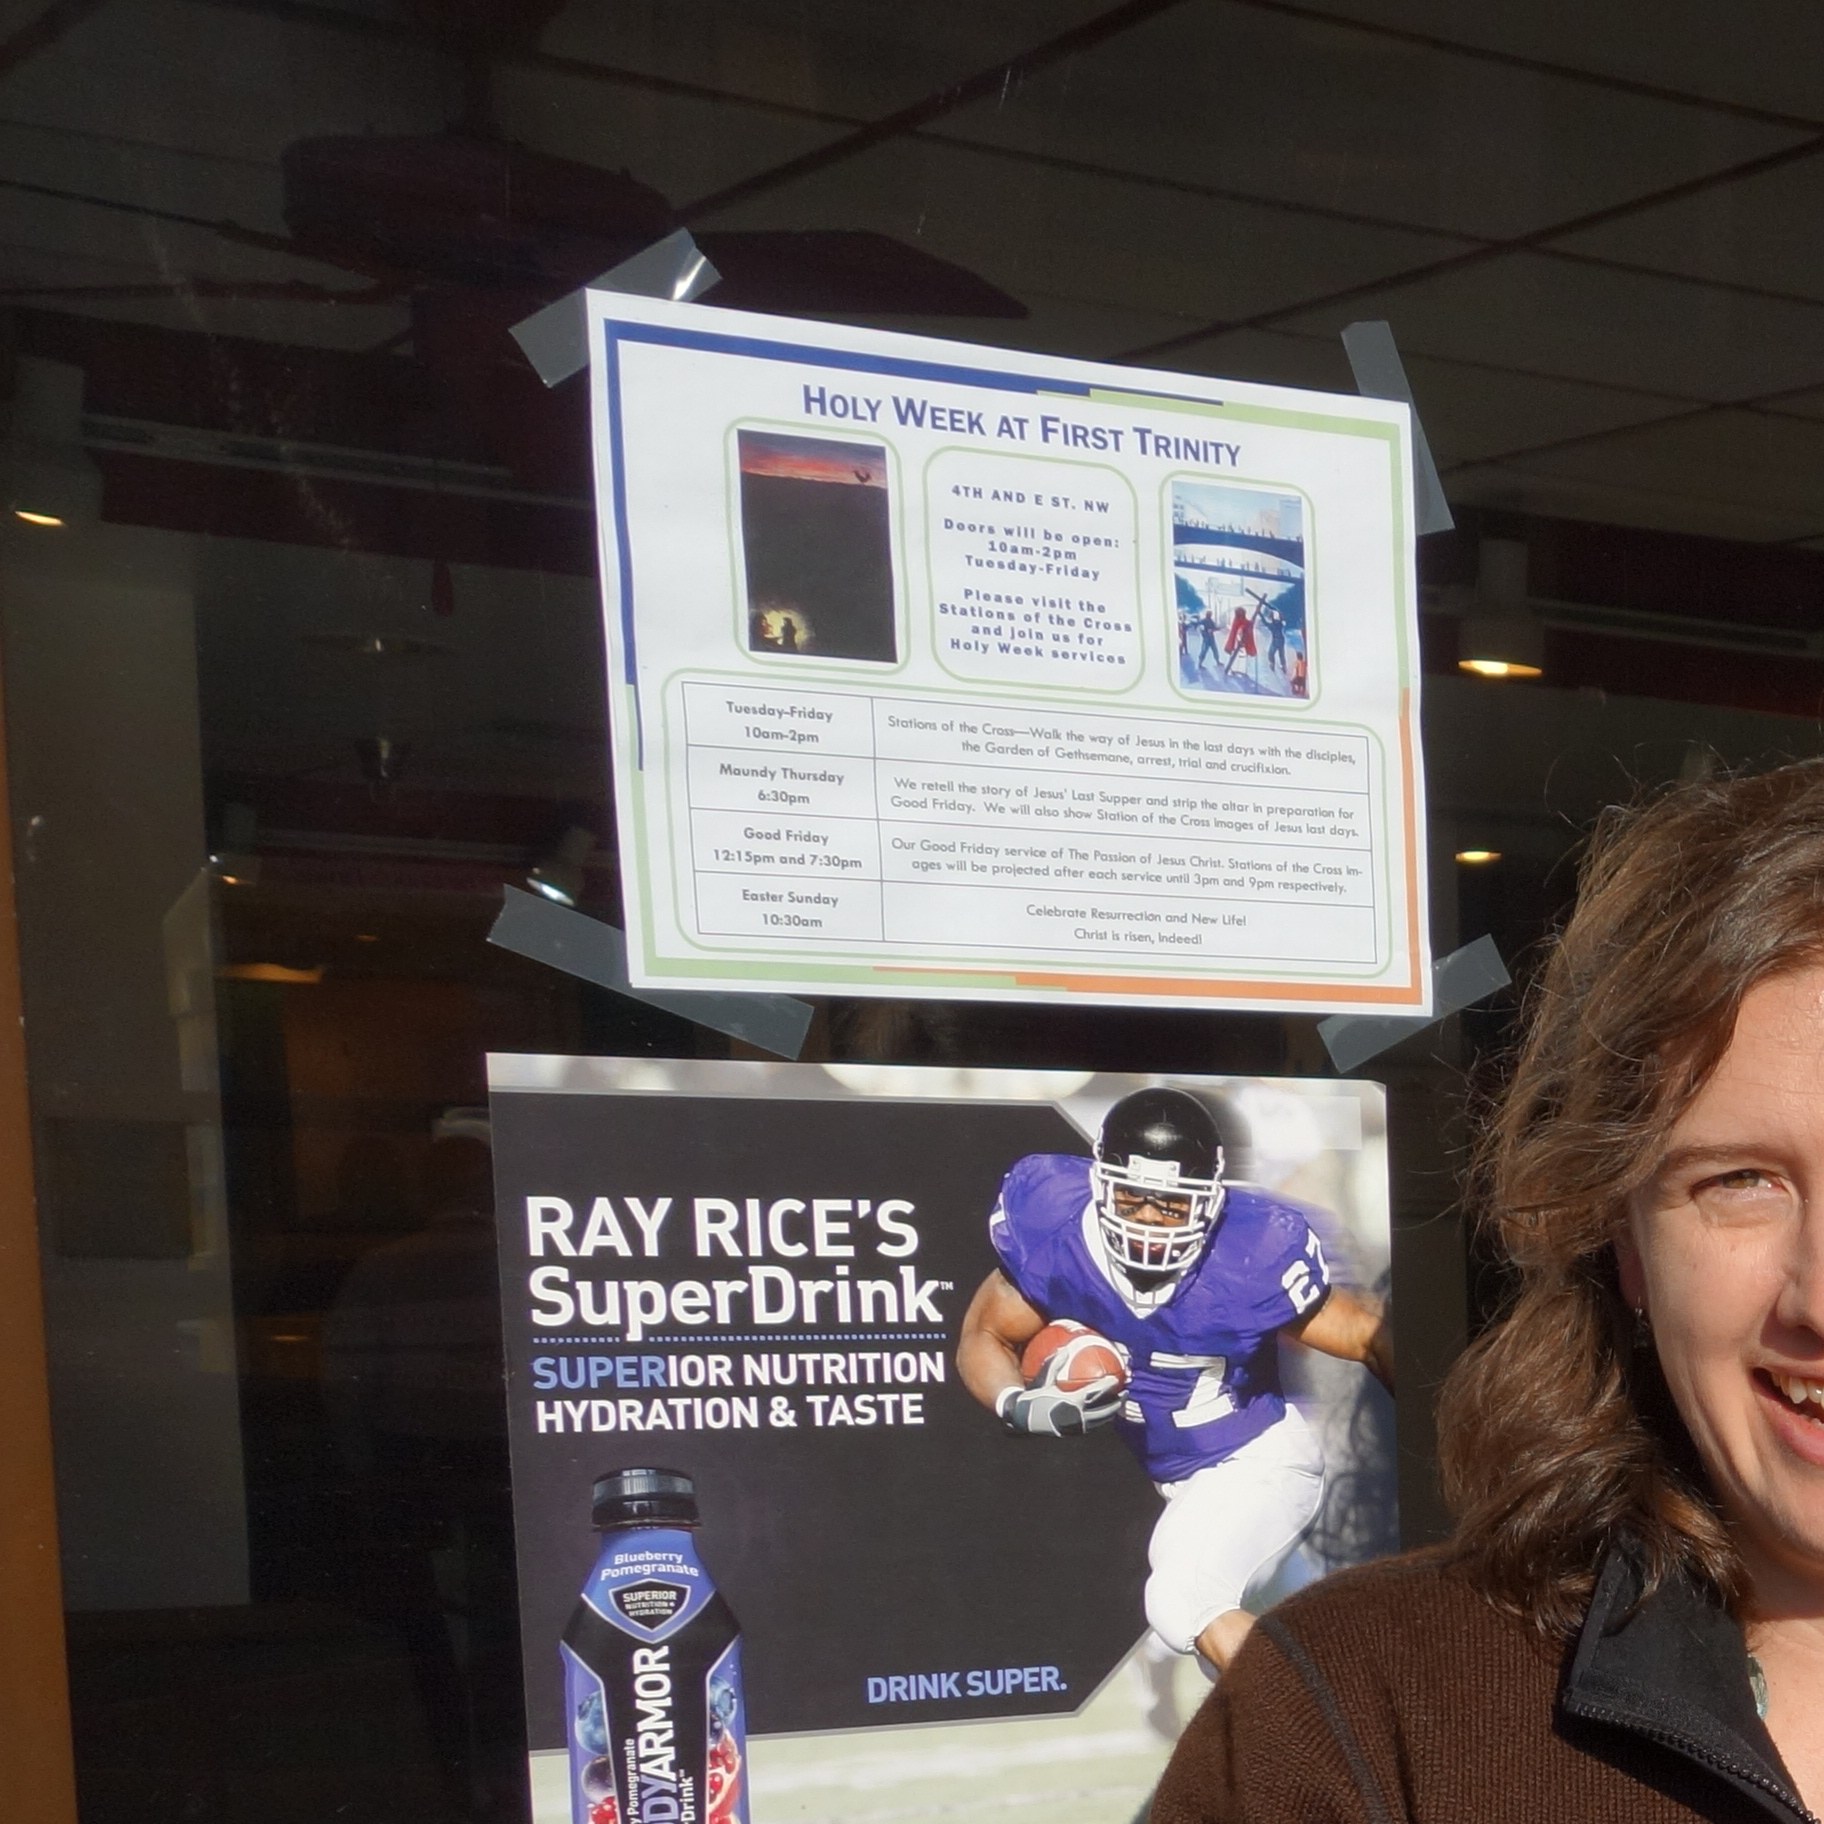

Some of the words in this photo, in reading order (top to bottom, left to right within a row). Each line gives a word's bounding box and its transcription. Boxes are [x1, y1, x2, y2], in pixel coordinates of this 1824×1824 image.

[803, 384, 882, 422] HOLY
[892, 396, 986, 436] WEEK
[997, 415, 1029, 440] AT
[1040, 415, 1124, 452] FIRST
[1132, 426, 1240, 467] TRINITY
[952, 485, 983, 499] 4TH
[991, 490, 1026, 504] AND
[1034, 494, 1043, 506] E
[1051, 496, 1076, 510] ST.
[1084, 500, 1109, 513] NW
[944, 518, 996, 535] Doors
[1003, 526, 1035, 539] will
[1043, 529, 1063, 542] be
[1071, 535, 1119, 548] open:
[988, 540, 1076, 561] 10am-2pm
[965, 554, 1099, 582] Tuesday-Friday
[964, 588, 1024, 605] Please
[1032, 596, 1071, 610] visit
[1078, 600, 1106, 613] the
[939, 603, 1015, 621] Stations
[1023, 612, 1040, 624] of
[1048, 614, 1076, 627] the
[1083, 617, 1132, 632] Cross
[971, 625, 1002, 636] and
[1010, 626, 1044, 640] join
[1052, 633, 1070, 643] us
[1078, 633, 1103, 646] for
[950, 638, 989, 654] Holy
[997, 642, 1043, 657] Week
[1051, 650, 1126, 664] services
[726, 700, 833, 723] Tuesday-Friday
[745, 726, 819, 744] 10am-2pm
[888, 715, 938, 731] Stations
[941, 720, 954, 732] of
[959, 721, 978, 734] the
[1066, 729, 1085, 742] the
[1088, 735, 1114, 747] way
[1117, 734, 1130, 746] of
[1135, 735, 1166, 748] Jesus
[1168, 738, 1179, 749] in
[1182, 738, 1200, 751] the
[1203, 740, 1223, 753] last
[1226, 742, 1255, 757] days
[1258, 746, 1281, 757] with
[1284, 746, 1302, 759] the
[719, 763, 777, 781] Maundy
[780, 767, 844, 786] Thursday
[758, 789, 810, 806] 6:30pm
[894, 777, 917, 790] We
[921, 780, 954, 792] retell
[958, 781, 978, 794] the
[981, 785, 1011, 799] story
[1015, 785, 1028, 797] of
[1072, 789, 1095, 802] Last
[1098, 790, 1142, 807] Supper
[1146, 795, 1169, 807] and
[1172, 798, 1198, 811] strip
[1200, 798, 1218, 810] the
[1222, 800, 1250, 812] altar
[1252, 802, 1263, 813] in
[1266, 806, 1335, 818] preparation
[1338, 807, 1354, 820] for
[890, 795, 928, 809] Good
[932, 798, 976, 815] Friday.
[983, 801, 1006, 814] We
[1009, 804, 1030, 815] will
[1034, 805, 1060, 818] also
[1063, 806, 1093, 819] show
[1097, 808, 1138, 822] Station
[1141, 812, 1154, 824] of
[1158, 813, 1177, 825] the
[1180, 814, 1210, 828] Cross
[1257, 820, 1270, 831] of
[1274, 821, 1303, 834] Jesus
[1306, 823, 1326, 835] last
[744, 827, 782, 841] Good
[785, 829, 829, 846] Friday
[714, 849, 775, 866] 12:15pm
[779, 853, 806, 865] and
[809, 854, 862, 870] 7:30pm
[891, 837, 916, 850] Our
[920, 839, 956, 853] Good
[960, 841, 1000, 858] Friday
[1004, 846, 1047, 858] service
[1050, 847, 1064, 859] of
[1068, 848, 1090, 861] The
[1094, 850, 1136, 863] Passion
[1139, 853, 1152, 864] of
[1156, 854, 1186, 866] Jesus
[1189, 855, 1225, 868] Christ.
[1228, 858, 1273, 872] Stations
[1276, 860, 1288, 872] of
[1292, 862, 1310, 874] the
[1312, 862, 1343, 876] Cross
[742, 889, 784, 902] Easter
[788, 891, 838, 908] Sunday
[762, 913, 823, 928] 10:30am
[1026, 904, 1087, 919] Celebrate
[1090, 908, 1162, 922] Resurrection
[1165, 912, 1188, 924] and
[1192, 913, 1218, 925] New
[1074, 928, 1108, 940] Christ
[1111, 930, 1120, 941] is
[525, 1195, 673, 1258] RAY
[693, 1196, 919, 1259] RICE'S
[532, 1354, 734, 1390] SUPERIOR
[743, 1350, 946, 1388] NUTRITION
[536, 1395, 760, 1434] HYDRATION
[768, 1394, 798, 1428] &
[805, 1392, 926, 1427] TASTE
[613, 1550, 684, 1566] Blueberry
[600, 1563, 699, 1581] Pomegranate
[622, 1589, 678, 1603] SUPERIOR
[867, 1671, 962, 1704] DRINK
[966, 1665, 1068, 1697] SUPER.
[623, 1737, 640, 1816] Pomegranate
